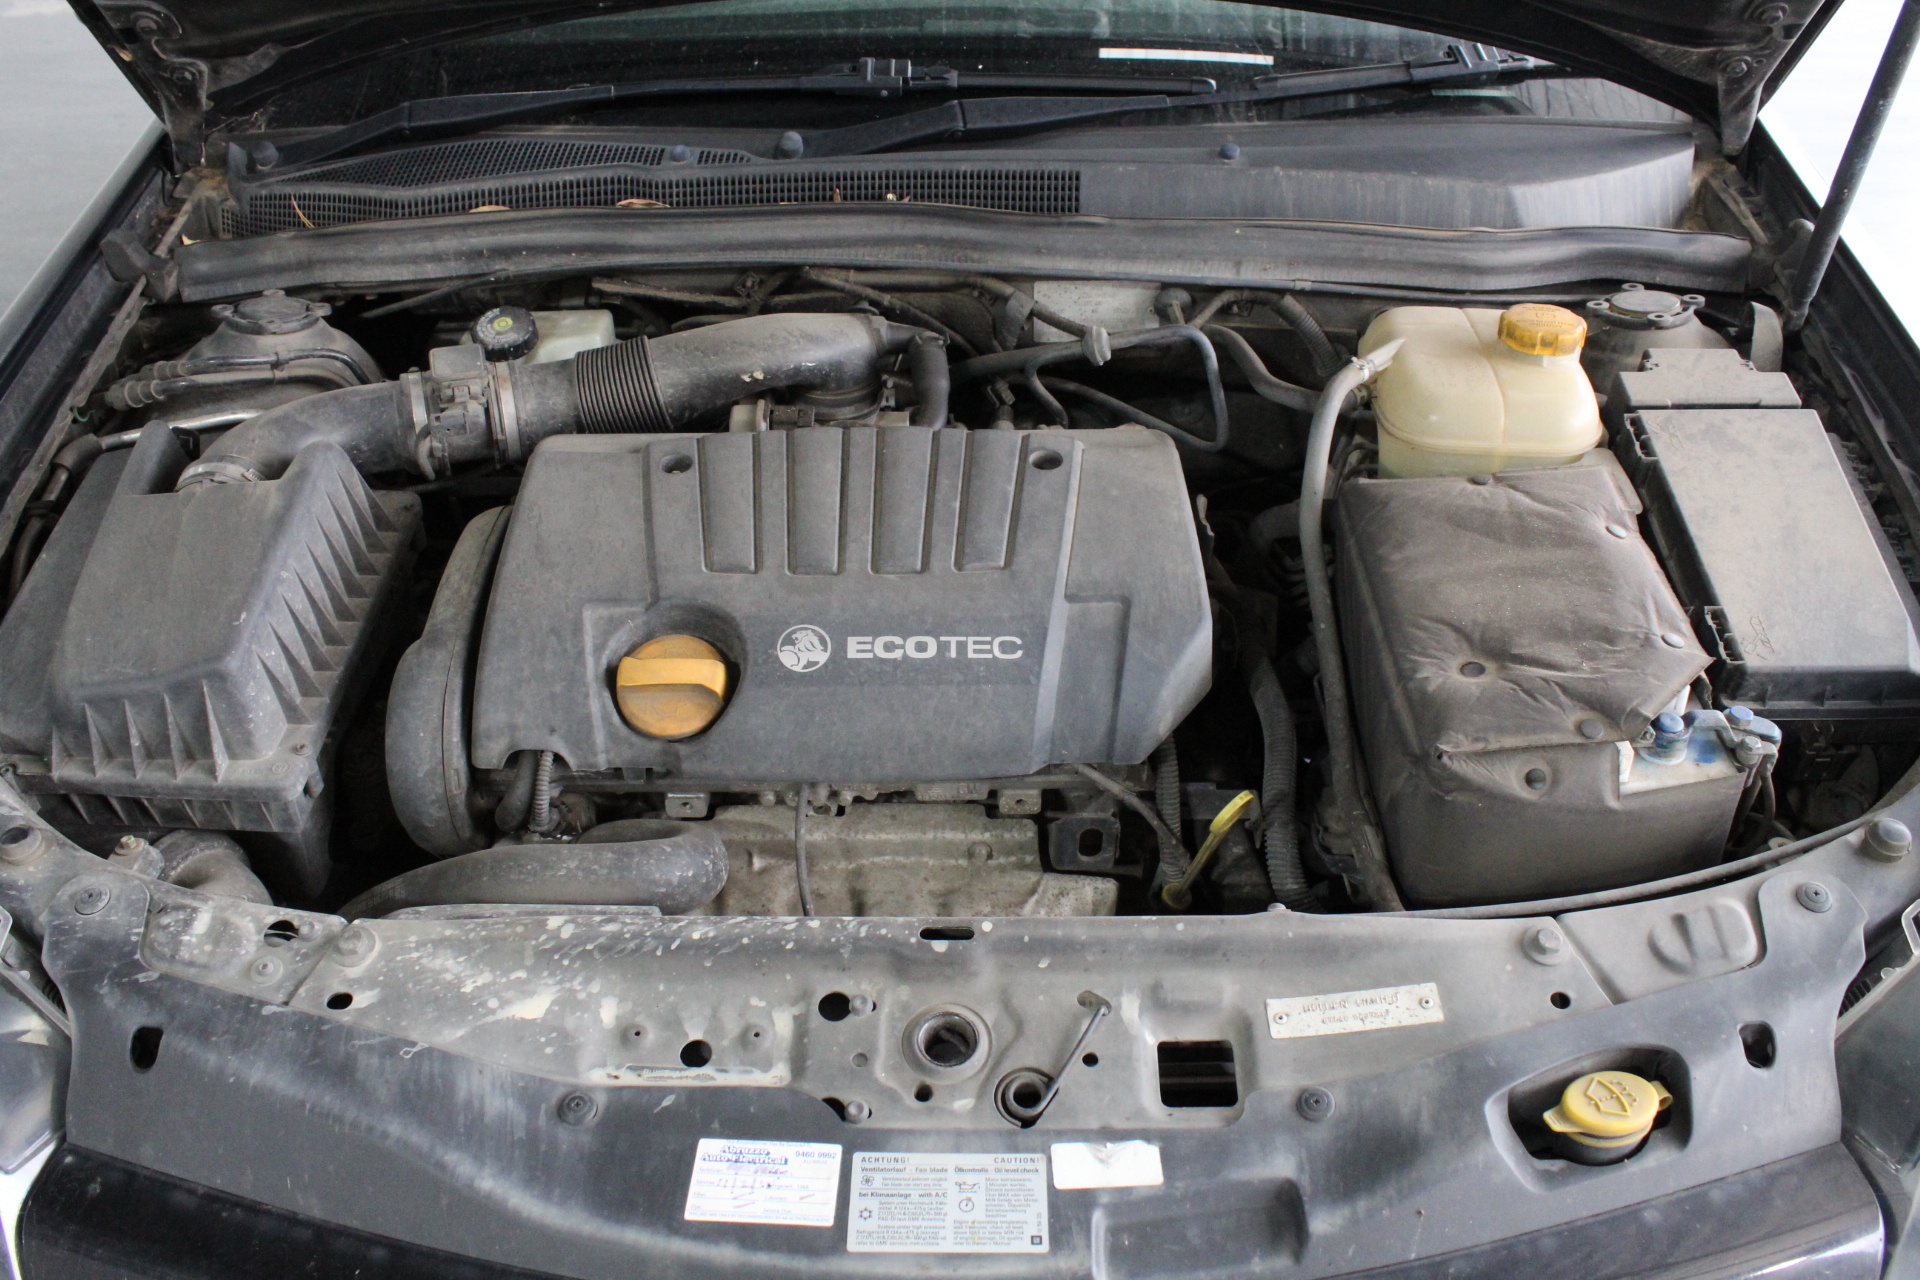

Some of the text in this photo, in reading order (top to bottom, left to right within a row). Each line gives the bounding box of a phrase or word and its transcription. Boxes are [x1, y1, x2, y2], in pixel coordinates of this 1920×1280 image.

[847, 636, 1023, 659] ECOTEC
[720, 1145, 770, 1156] Abruzzo
[795, 1151, 815, 1159] 9460
[700, 1152, 788, 1166] Auto Electrical
